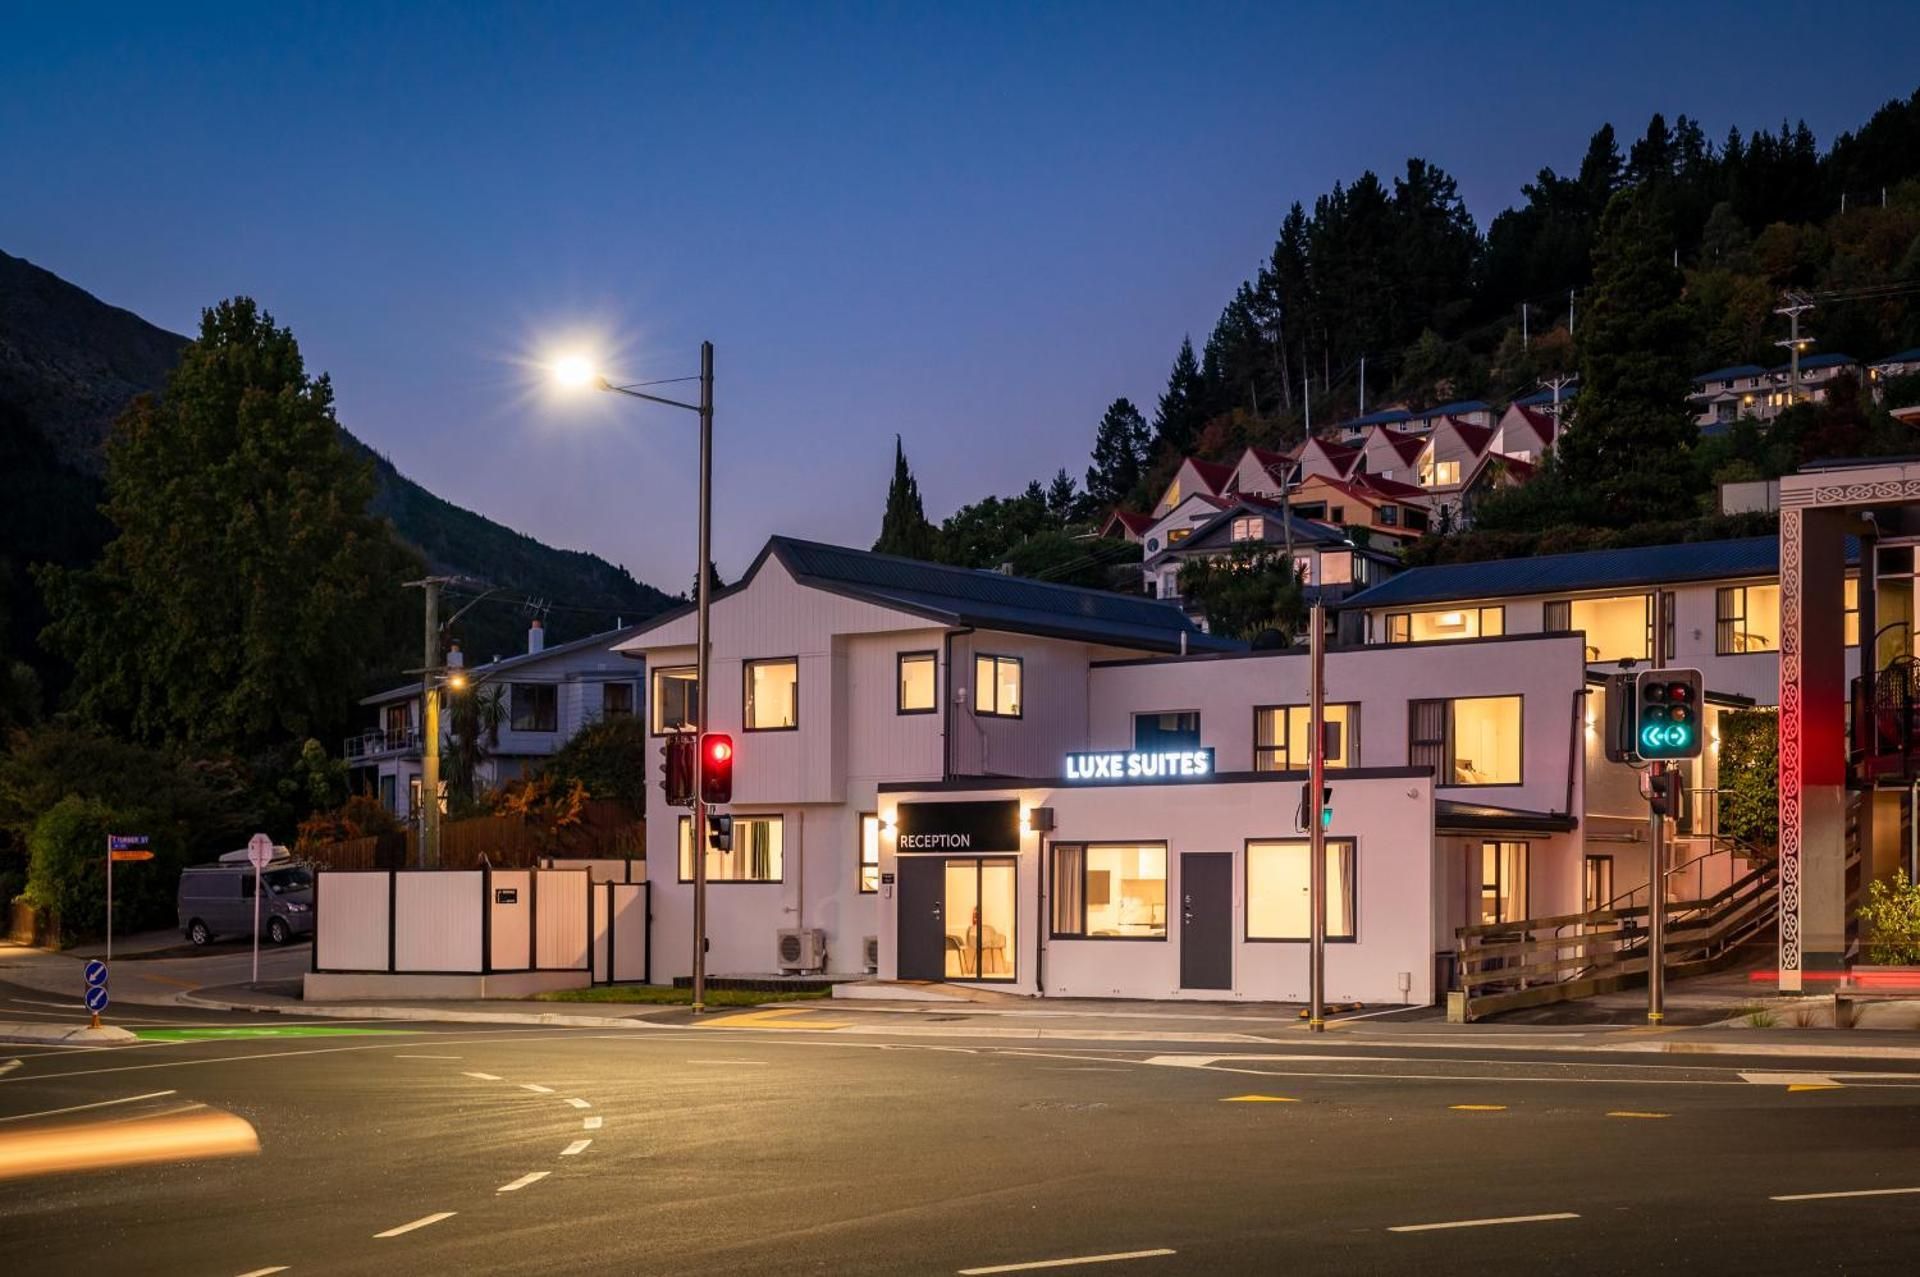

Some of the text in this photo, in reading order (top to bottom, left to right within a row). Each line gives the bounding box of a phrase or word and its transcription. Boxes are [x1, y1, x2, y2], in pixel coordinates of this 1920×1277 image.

[1066, 751, 1208, 779] LUXE SUITES
[900, 833, 970, 848] RECEPTION
